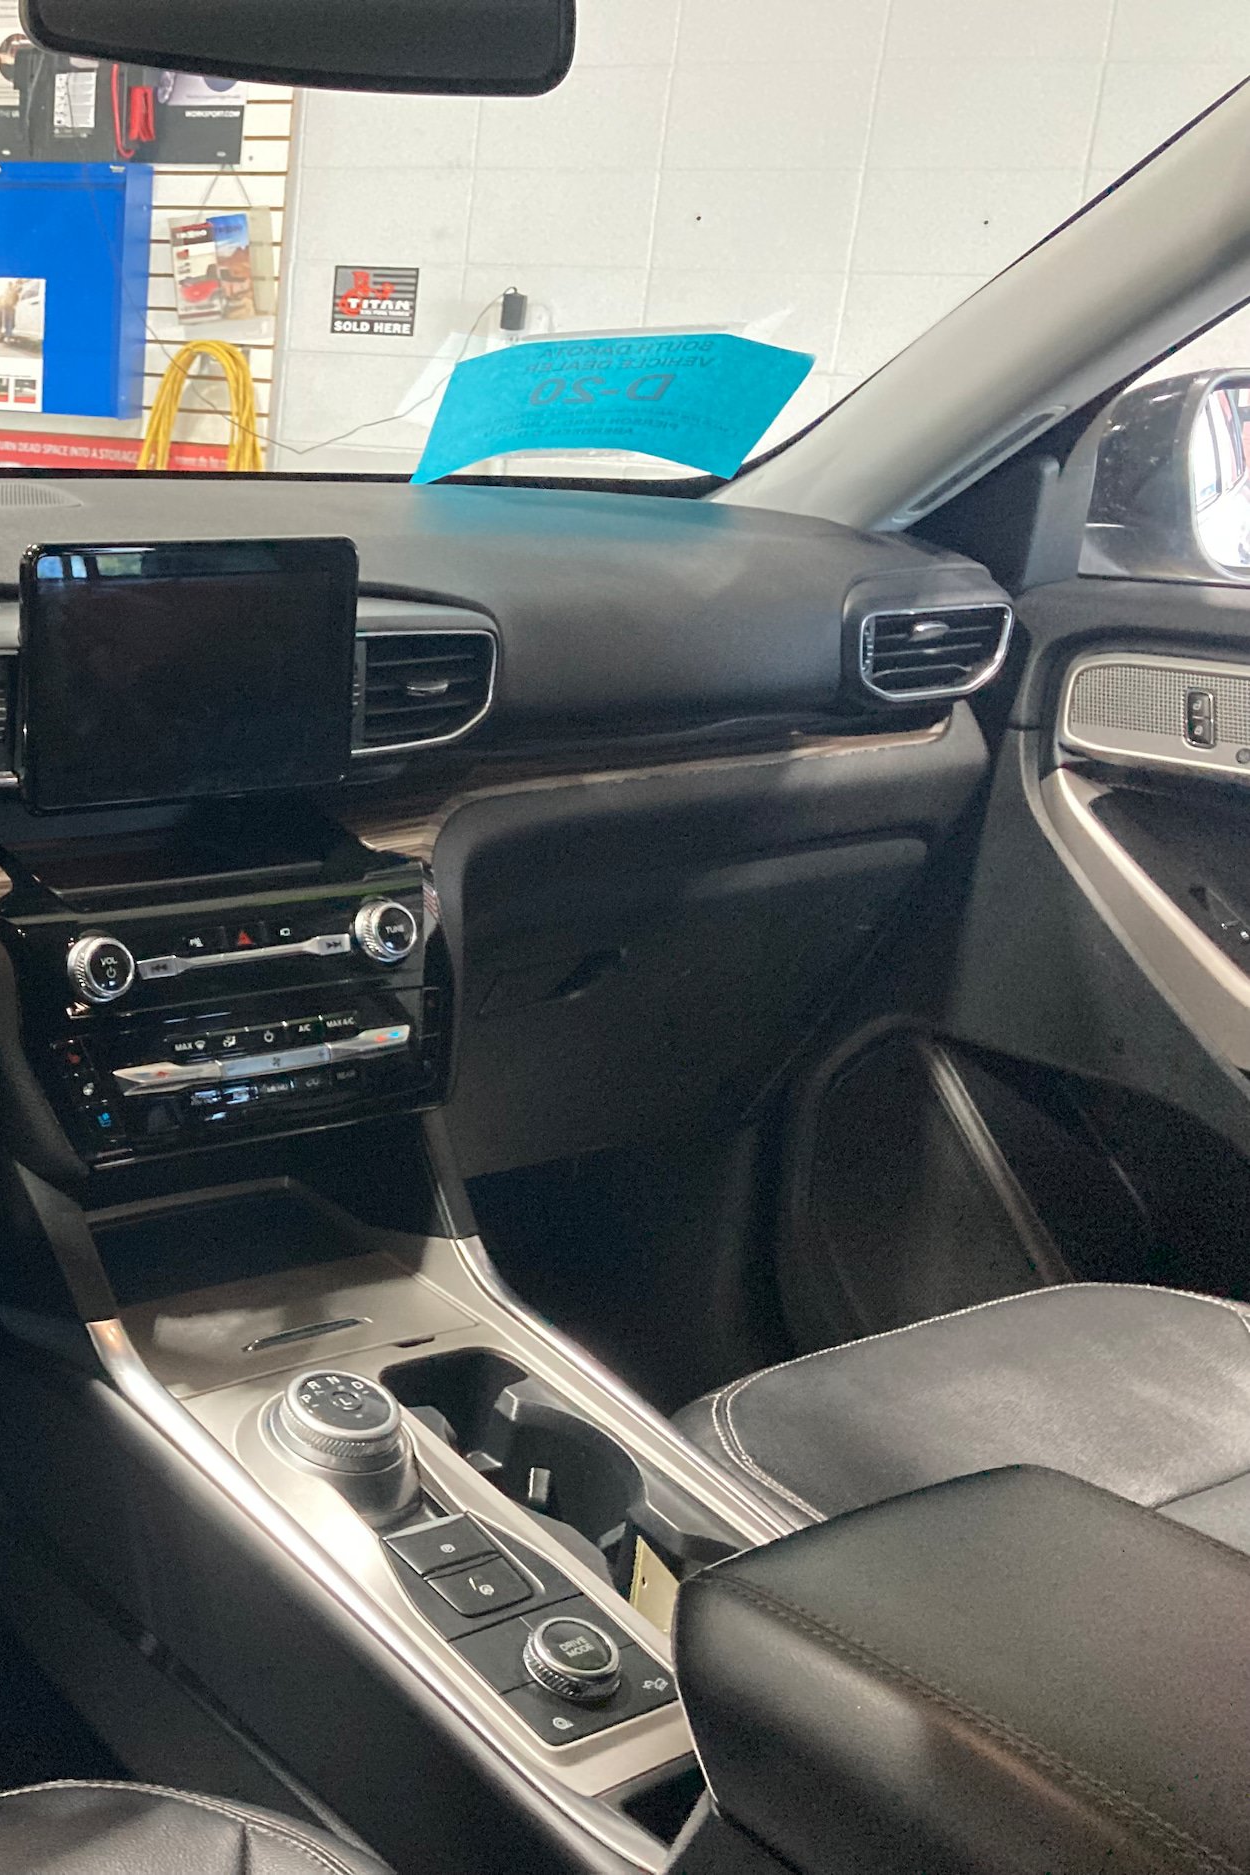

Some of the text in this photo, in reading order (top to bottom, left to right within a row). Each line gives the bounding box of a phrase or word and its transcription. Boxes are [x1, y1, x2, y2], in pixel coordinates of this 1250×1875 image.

[347, 298, 410, 310] TITAN
[333, 320, 411, 334] SOLD HERE
[18, 442, 42, 454] DEAD
[43, 444, 68, 457] SPACE
[70, 447, 90, 459] INTO
[100, 957, 118, 967] VOL
[174, 1042, 193, 1051] MAX
[306, 1380, 321, 1390] R
[325, 1375, 341, 1385] N
[351, 1381, 364, 1390] D
[300, 1393, 312, 1403] P
[558, 1635, 588, 1652] DRIVE
[565, 1642, 595, 1658] MODE
